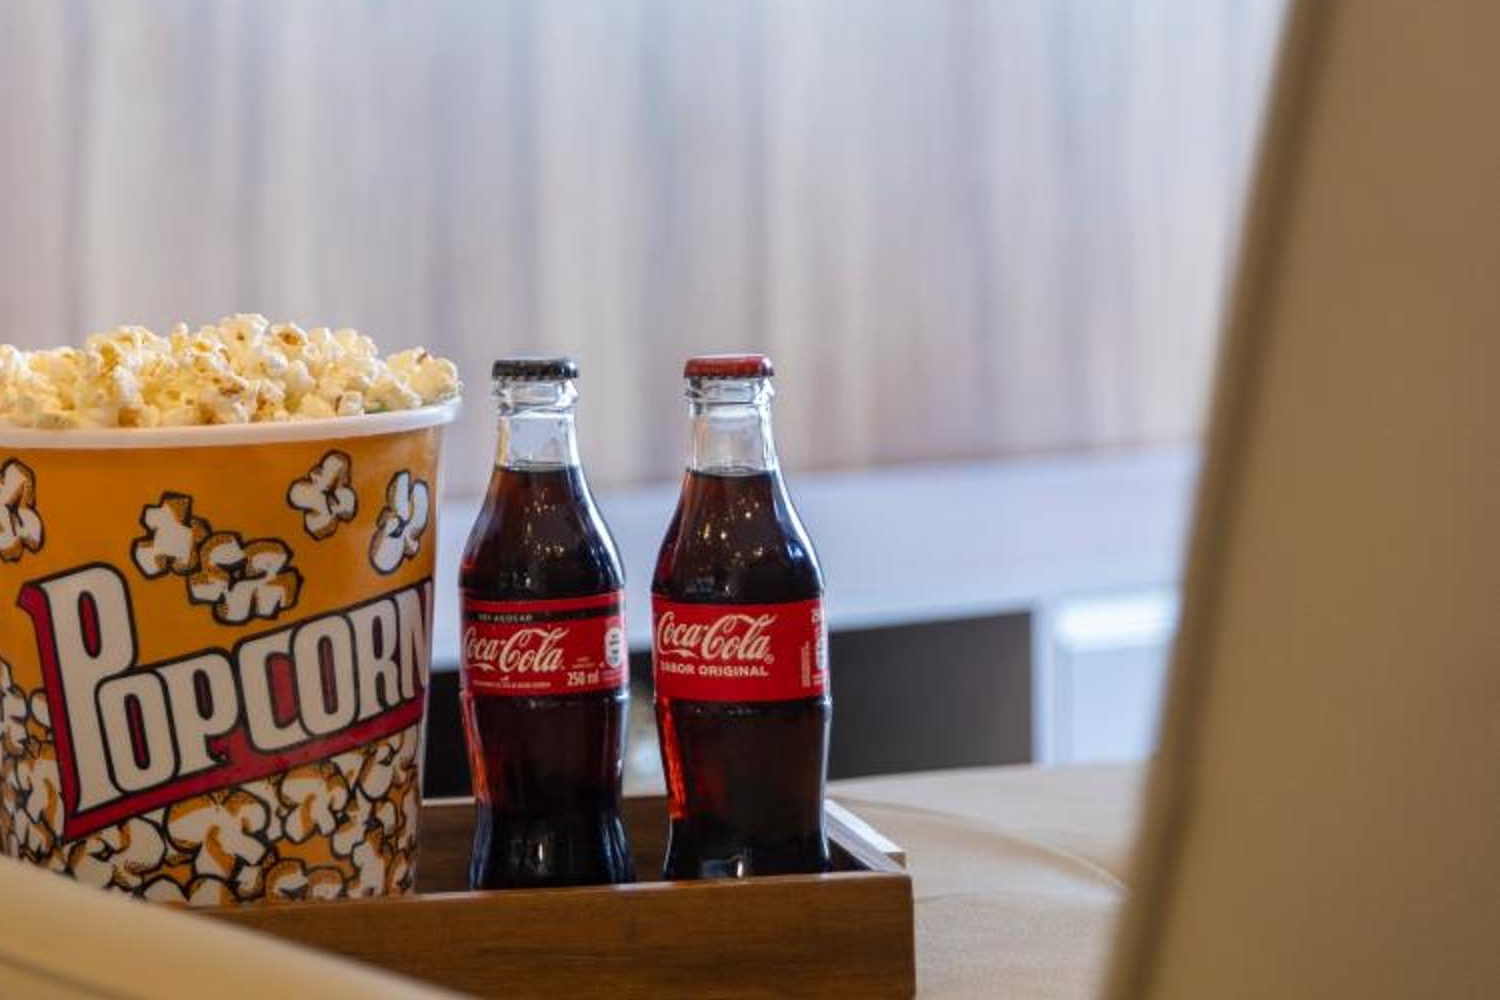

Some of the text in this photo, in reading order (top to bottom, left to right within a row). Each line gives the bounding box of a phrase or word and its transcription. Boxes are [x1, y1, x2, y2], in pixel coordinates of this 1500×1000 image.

[463, 626, 570, 673] Coca-Cola
[658, 611, 778, 660] Coca-Cola
[30, 562, 434, 816] POPCORN
[566, 671, 585, 687] 250
[698, 664, 769, 677] ORIGINAL
